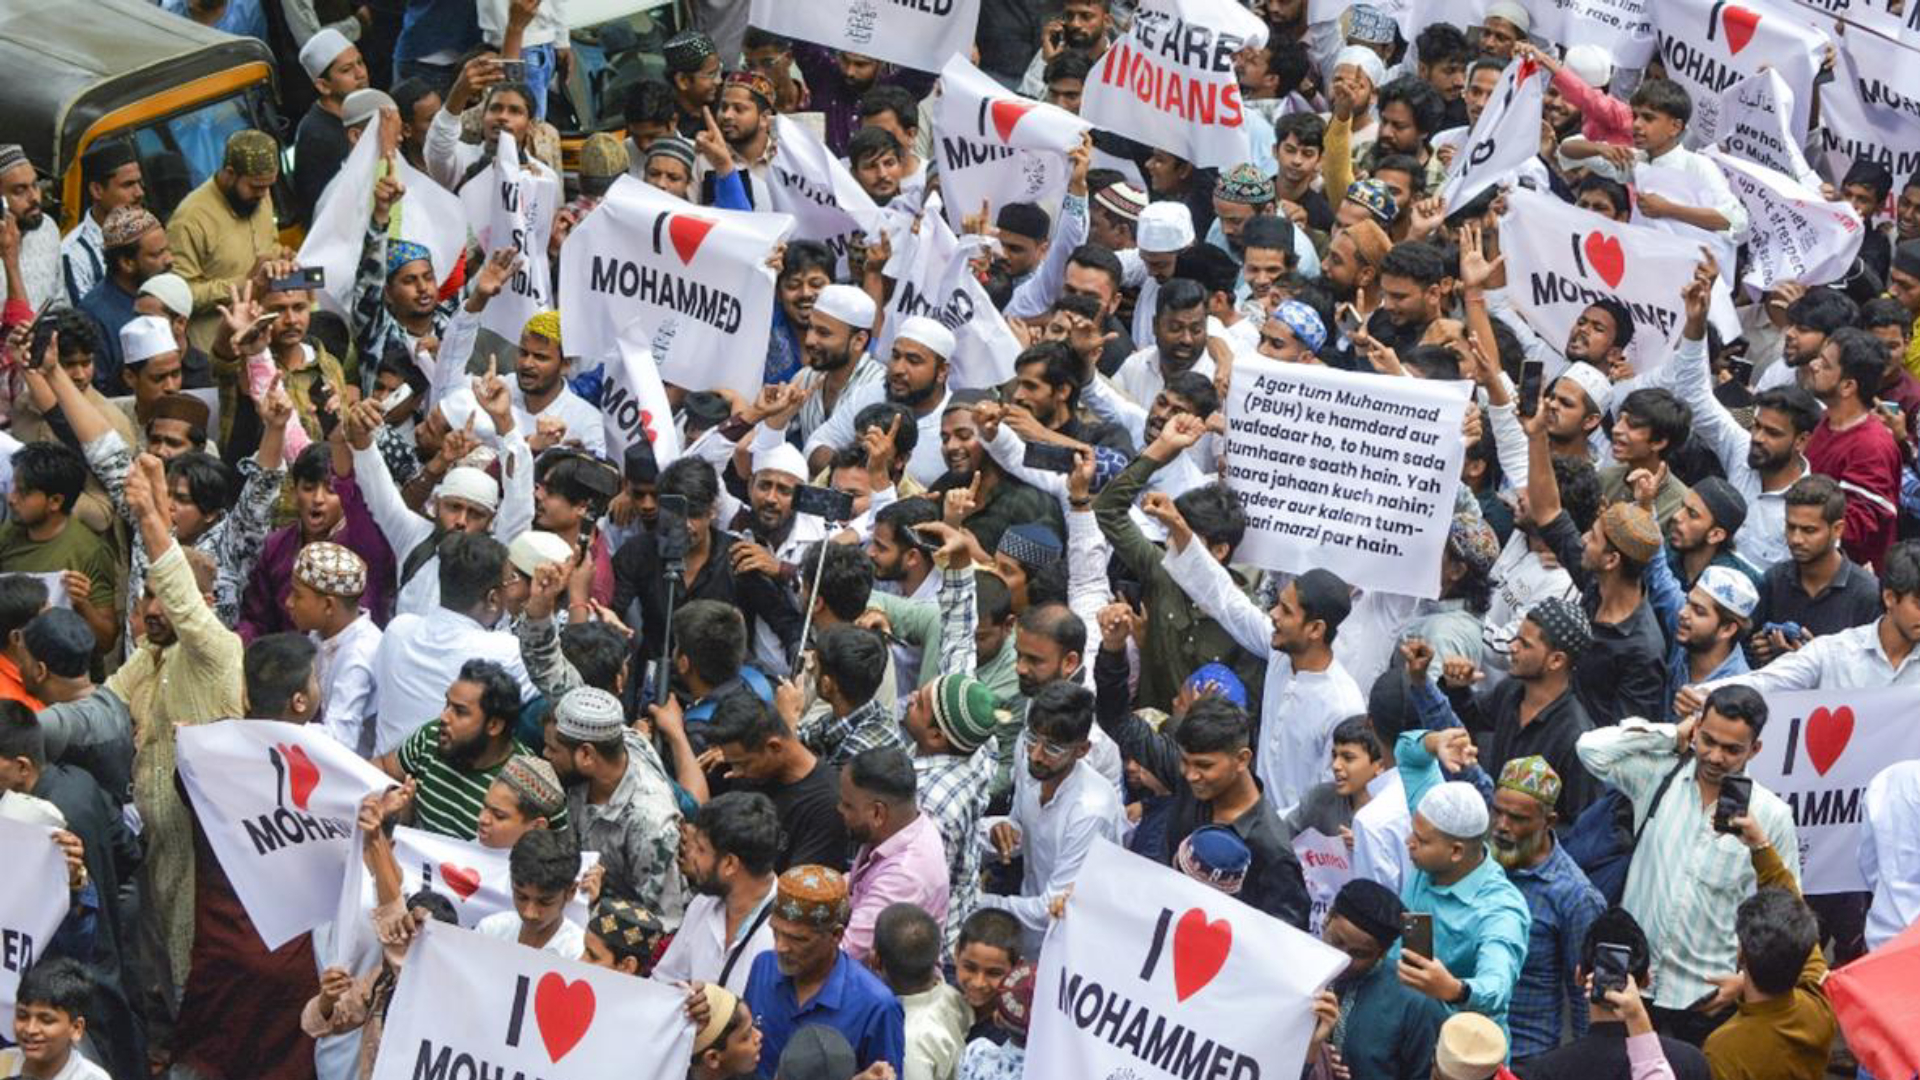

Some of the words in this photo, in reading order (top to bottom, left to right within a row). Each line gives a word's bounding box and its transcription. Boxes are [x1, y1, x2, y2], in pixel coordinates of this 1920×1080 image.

[1160, 17, 1245, 72] ARE
[1707, 0, 1726, 41] I
[1102, 41, 1244, 128] INDIANS
[1657, 29, 1745, 94] MOHAM
[979, 97, 990, 137] I
[652, 211, 670, 254] I
[1571, 233, 1587, 279] I
[590, 255, 742, 335] MOHAMMED
[1244, 392, 1303, 423] (PBUH)
[1305, 406, 1326, 424] ke
[1328, 410, 1409, 440] hamdard
[1409, 430, 1440, 446] aur
[1254, 375, 1297, 396] Agar
[1298, 383, 1333, 402] tum
[1334, 390, 1440, 422] Muhammad
[1227, 438, 1307, 467] tumhaare
[1308, 457, 1358, 478] saath
[1360, 463, 1402, 487] hain.
[1407, 473, 1441, 494] Yah
[1230, 418, 1310, 444] wafadaar
[1310, 431, 1336, 452] ho,
[1340, 437, 1358, 453] to
[1360, 440, 1400, 462] hum
[1402, 451, 1446, 472] sada
[1269, 469, 1329, 495] jahaan
[1331, 482, 1374, 504] kuch
[1376, 494, 1435, 518] nahin;
[1287, 500, 1317, 516] aur
[1318, 503, 1372, 528] kalam
[1375, 515, 1424, 536] tum-
[1273, 520, 1322, 540] marzi
[1319, 529, 1354, 546] par
[1356, 534, 1404, 557] hain.
[1782, 718, 1801, 776] I
[268, 746, 285, 807] I
[1139, 907, 1174, 982] I
[506, 974, 530, 1047] I
[1058, 966, 1261, 1080] MOHAMMED
